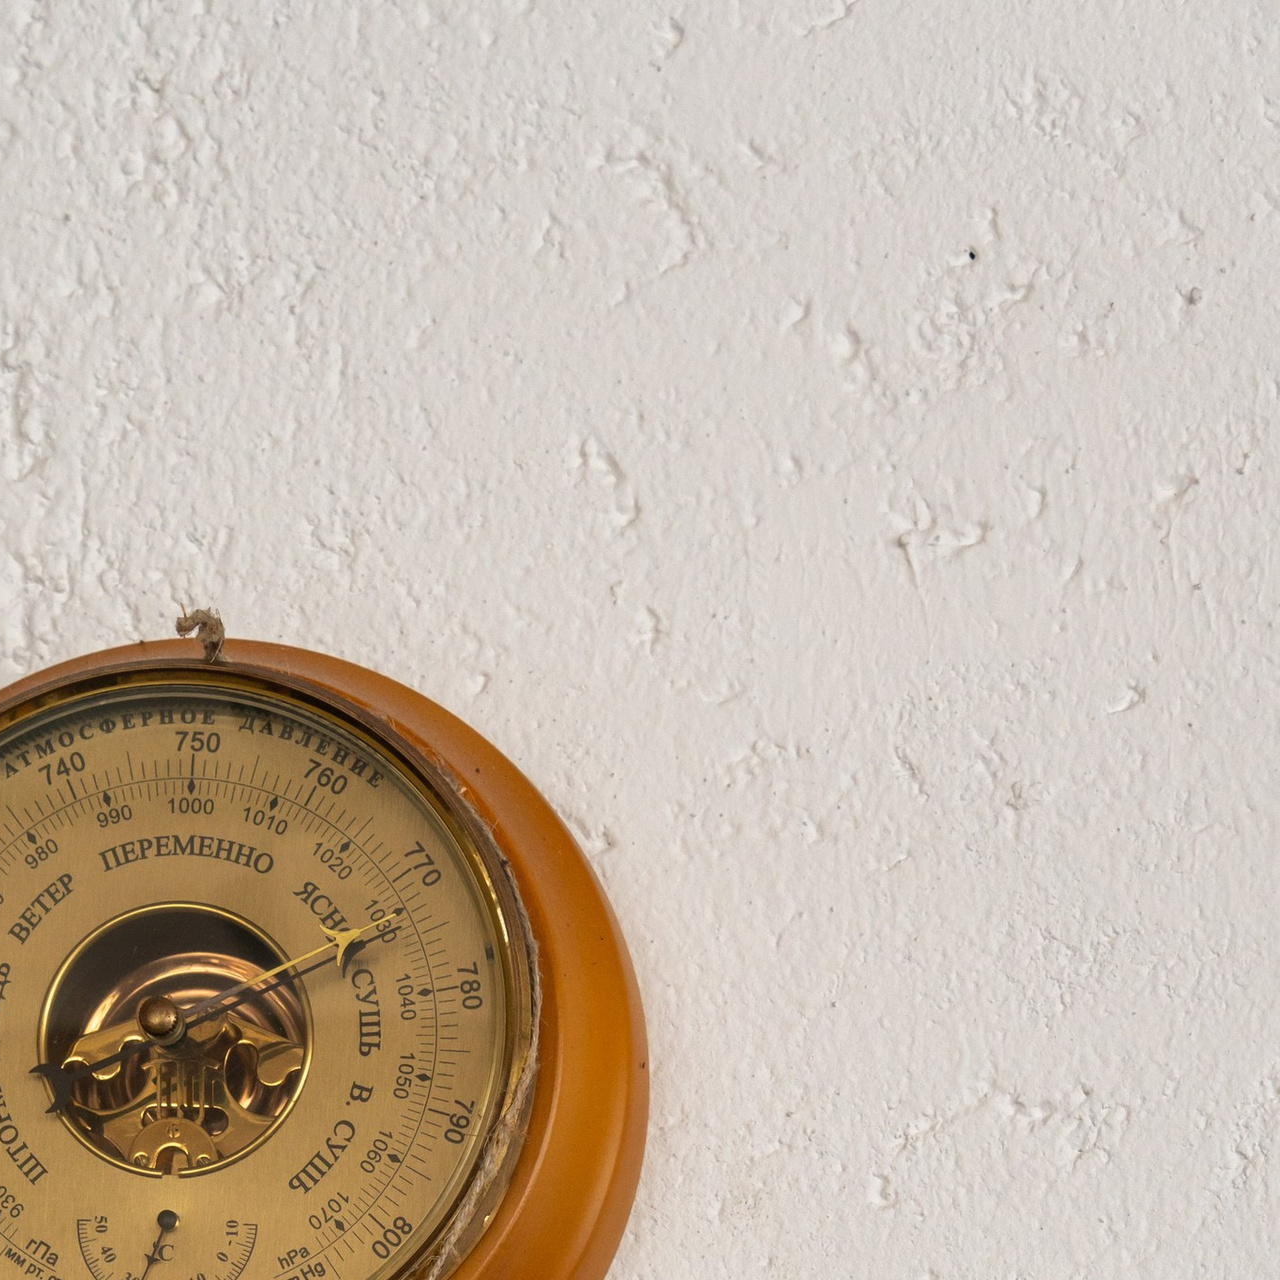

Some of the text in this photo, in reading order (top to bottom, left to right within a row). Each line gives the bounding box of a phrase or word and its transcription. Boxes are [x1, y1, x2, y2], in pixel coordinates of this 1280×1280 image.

[4, 707, 384, 788] АТМОСФЕРНОЕ ДАВЛЕНИЕ
[175, 731, 221, 753] 750
[38, 752, 86, 785] 740
[303, 758, 348, 795] 760
[96, 805, 133, 828] 990
[167, 798, 215, 815] 1000
[243, 806, 288, 835] 1010
[24, 838, 59, 870] 980
[98, 834, 274, 874] ПЕРЕМЕННО
[313, 841, 353, 880] 1020
[404, 841, 442, 887] 770
[7, 872, 75, 945] ВЕТЕР
[292, 881, 352, 947] ЯСН
[365, 899, 398, 944] 1030
[396, 973, 417, 1021] 1040
[457, 961, 483, 1010] 780
[351, 968, 382, 1057] СУШЬ
[393, 1052, 416, 1100] 1050
[288, 1080, 374, 1194] В. СУШЬ
[444, 1100, 475, 1145] 790
[360, 1130, 394, 1174] 1060
[94, 1215, 108, 1234] 50
[308, 1191, 350, 1230] 1070
[25, 1238, 59, 1267] гПа
[101, 1245, 117, 1263] 40
[216, 1251, 228, 1263] 0
[371, 1216, 413, 1259] 800
[4, 1247, 26, 1268] мм
[24, 1262, 45, 1280] рт.
[277, 1246, 310, 1270] hPa
[300, 1261, 326, 1280] Hg
